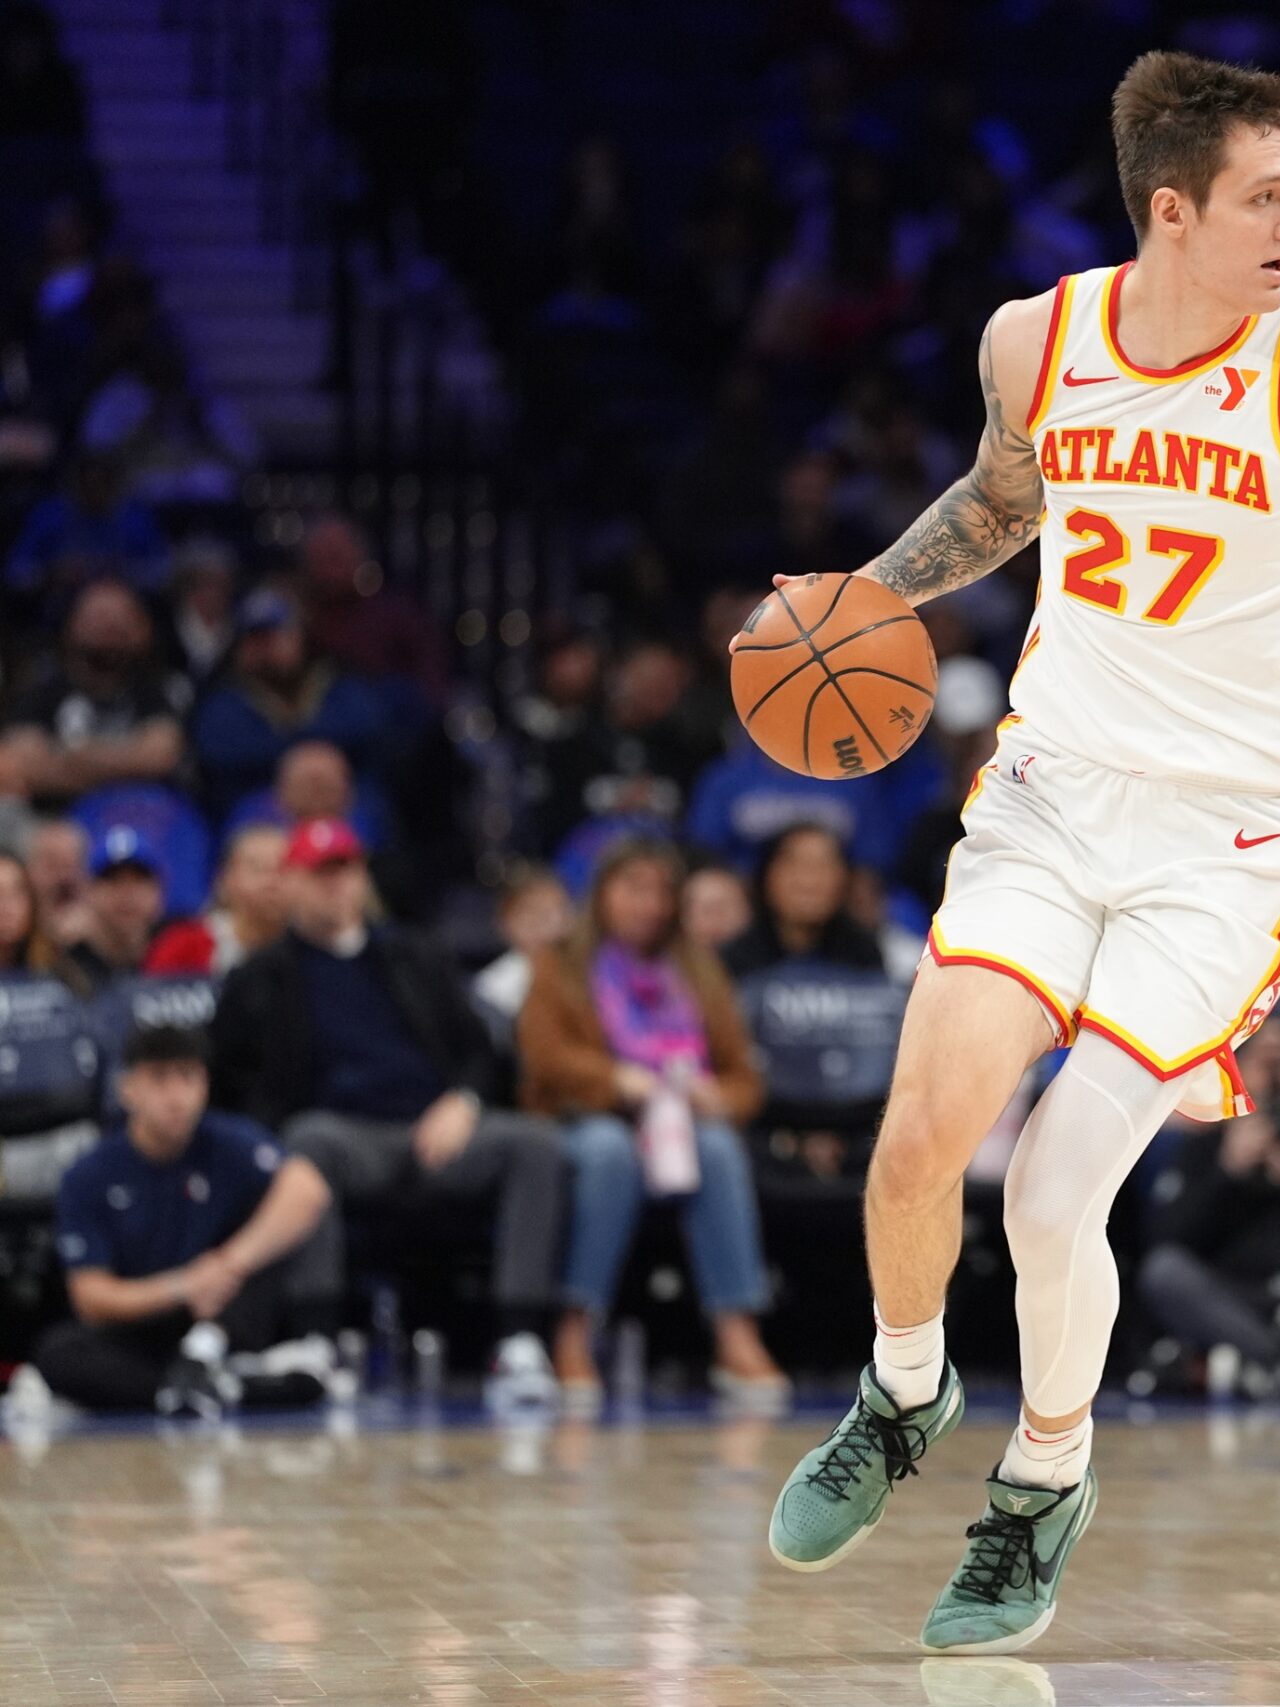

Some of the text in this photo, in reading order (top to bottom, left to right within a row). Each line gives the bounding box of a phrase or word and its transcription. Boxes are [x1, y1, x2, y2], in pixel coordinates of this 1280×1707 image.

[1204, 384, 1223, 397] the
[1039, 427, 1272, 514] ATLANTA
[1063, 506, 1225, 625] 27
